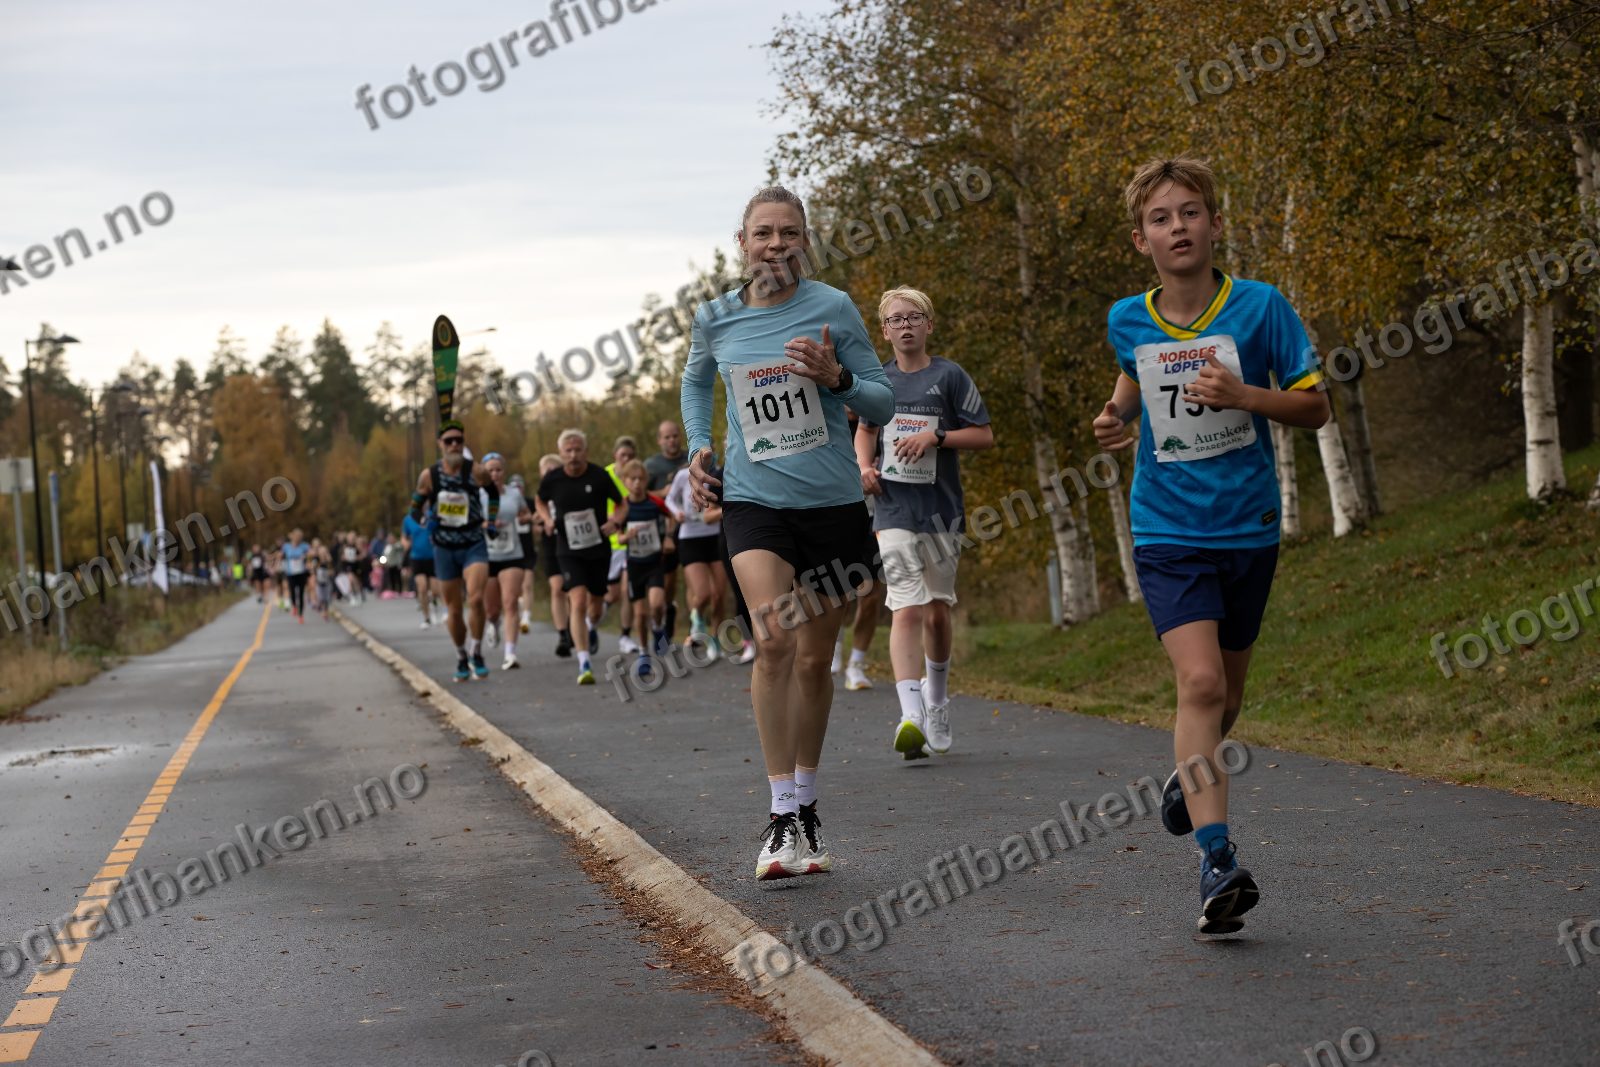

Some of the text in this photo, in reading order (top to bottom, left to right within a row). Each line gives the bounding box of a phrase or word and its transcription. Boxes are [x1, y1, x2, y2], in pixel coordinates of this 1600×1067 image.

[1157, 345, 1217, 363] NORGES
[747, 363, 796, 380] NORGE
[1164, 359, 1207, 374] LØPET
[754, 374, 790, 388] LØPET
[745, 387, 810, 425] 1011
[1160, 382, 1223, 419] 75
[895, 418, 929, 427] NORGES
[896, 425, 922, 433] LØPET
[780, 426, 825, 443] Aurskog
[1194, 422, 1251, 445] Aurskog
[1195, 436, 1243, 453] SPAREBANK
[901, 466, 934, 476] Aurskog
[573, 521, 592, 535] 110
